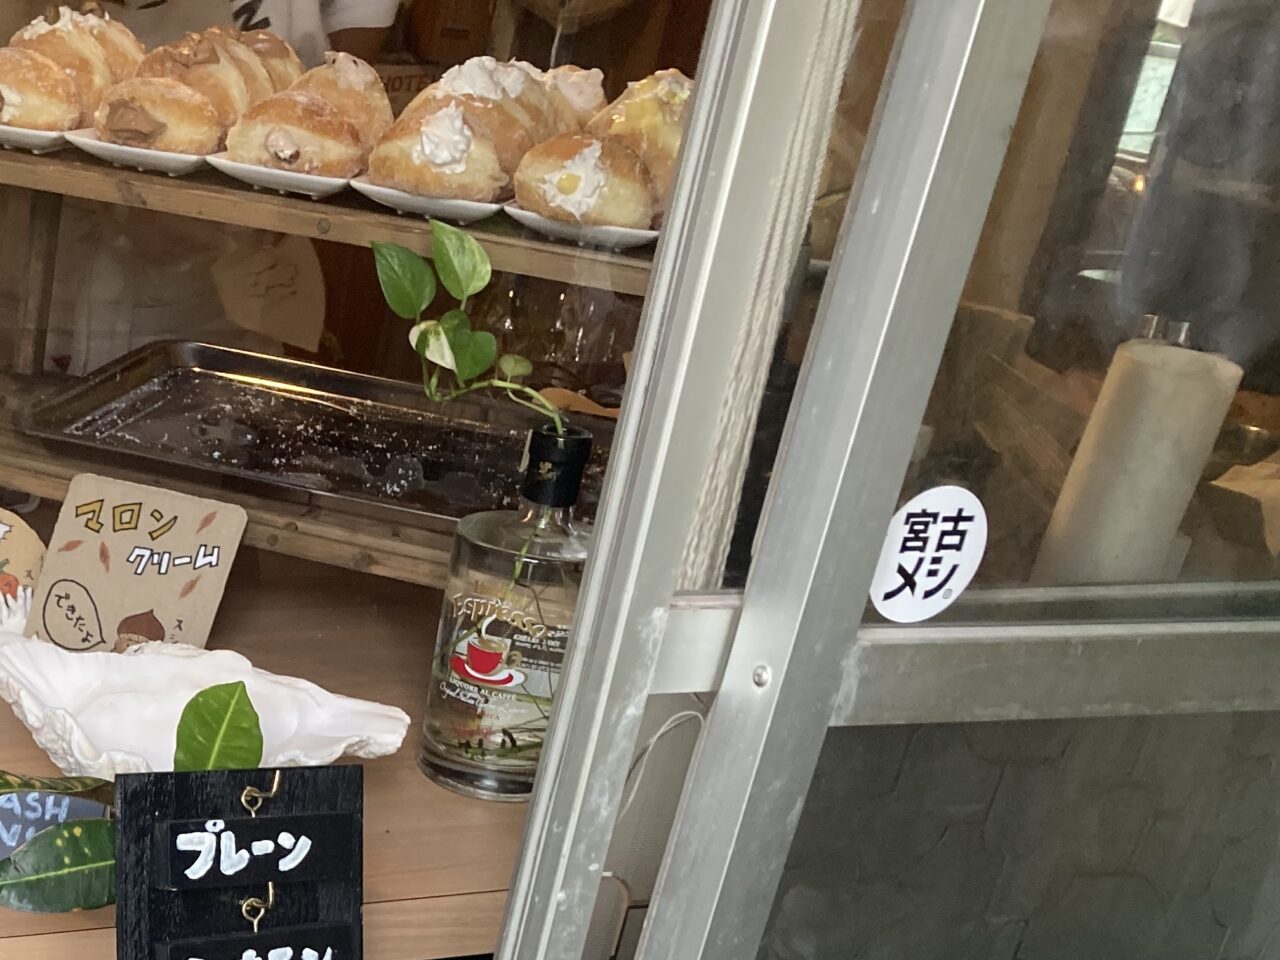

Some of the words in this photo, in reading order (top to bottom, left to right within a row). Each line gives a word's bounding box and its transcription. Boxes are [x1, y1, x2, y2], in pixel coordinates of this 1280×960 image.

[75, 498, 178, 541] マロン
[899, 507, 975, 553] 宮古
[127, 544, 221, 576] クリーム
[881, 556, 961, 601] メシ
[54, 592, 94, 643] できたよ
[449, 676, 479, 693] LIQUORE
[176, 819, 312, 880] プレーン
